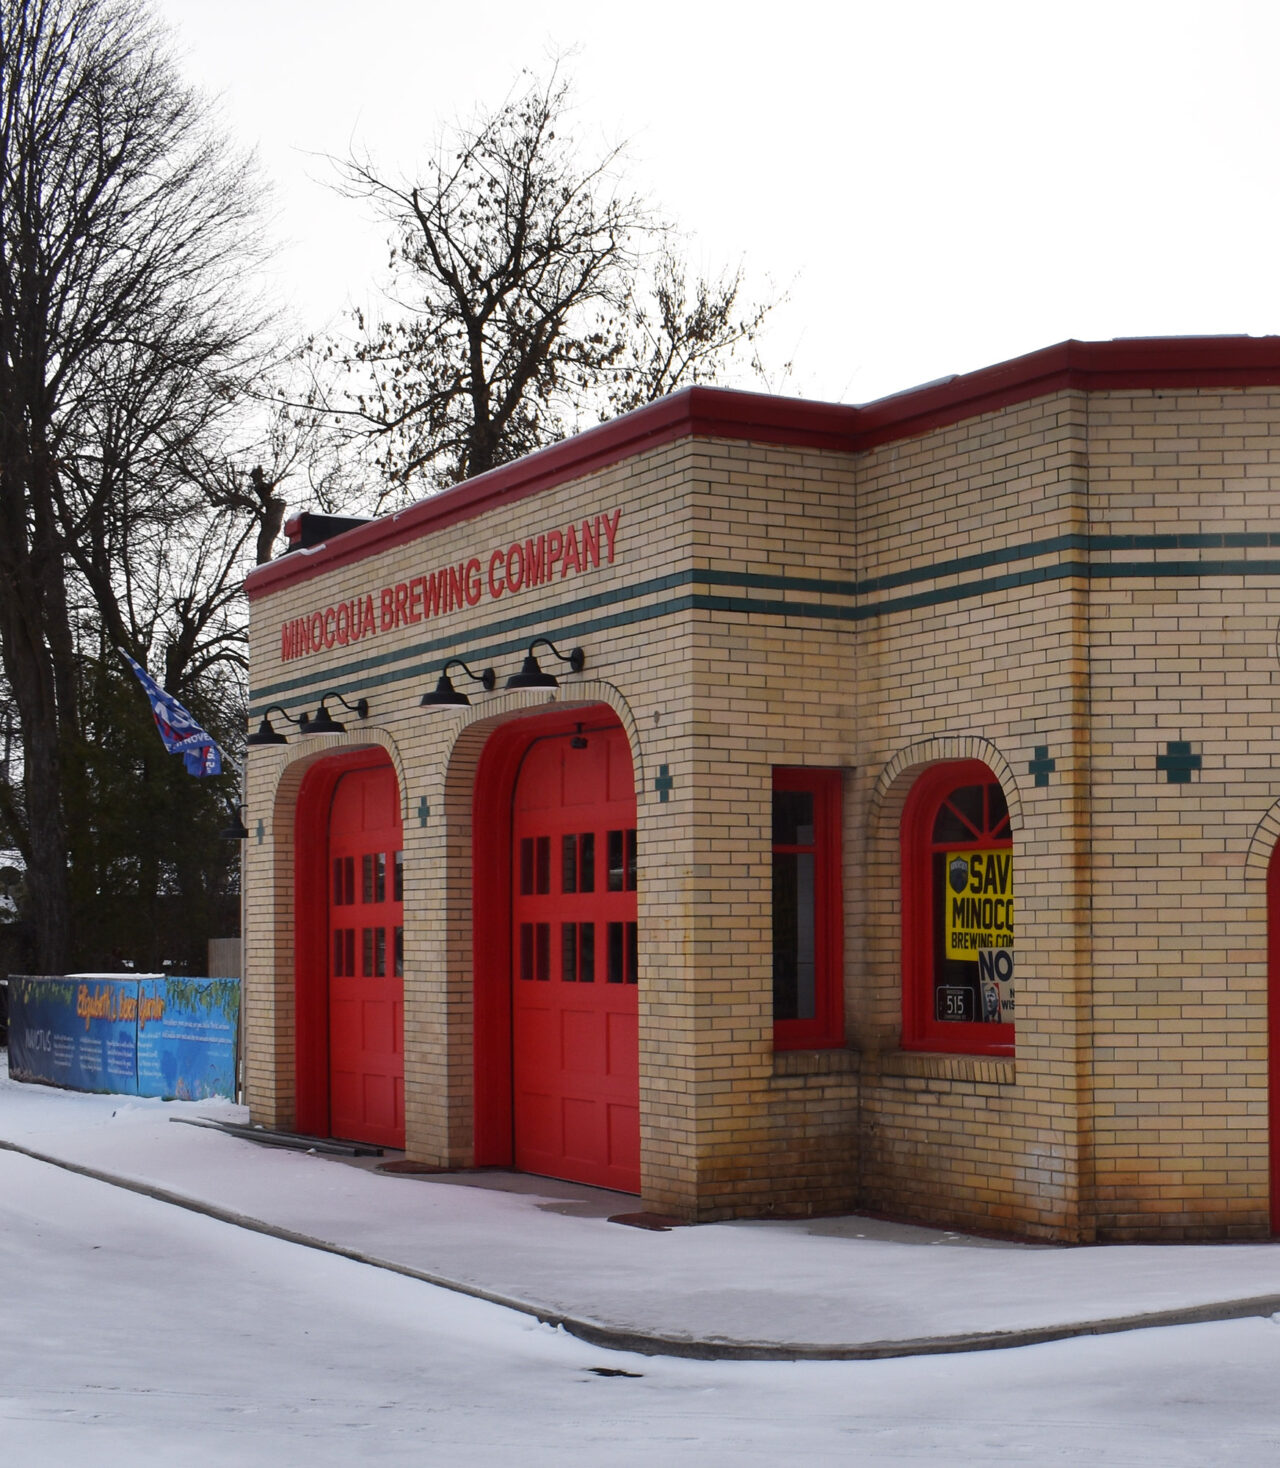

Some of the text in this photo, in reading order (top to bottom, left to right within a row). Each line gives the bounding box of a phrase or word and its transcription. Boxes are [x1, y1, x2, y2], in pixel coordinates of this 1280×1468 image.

[281, 508, 622, 662] MINOCQUA BREWING COMPANY
[969, 854, 1014, 895] SAV
[951, 932, 993, 949] BREWING
[946, 995, 964, 1014] 515
